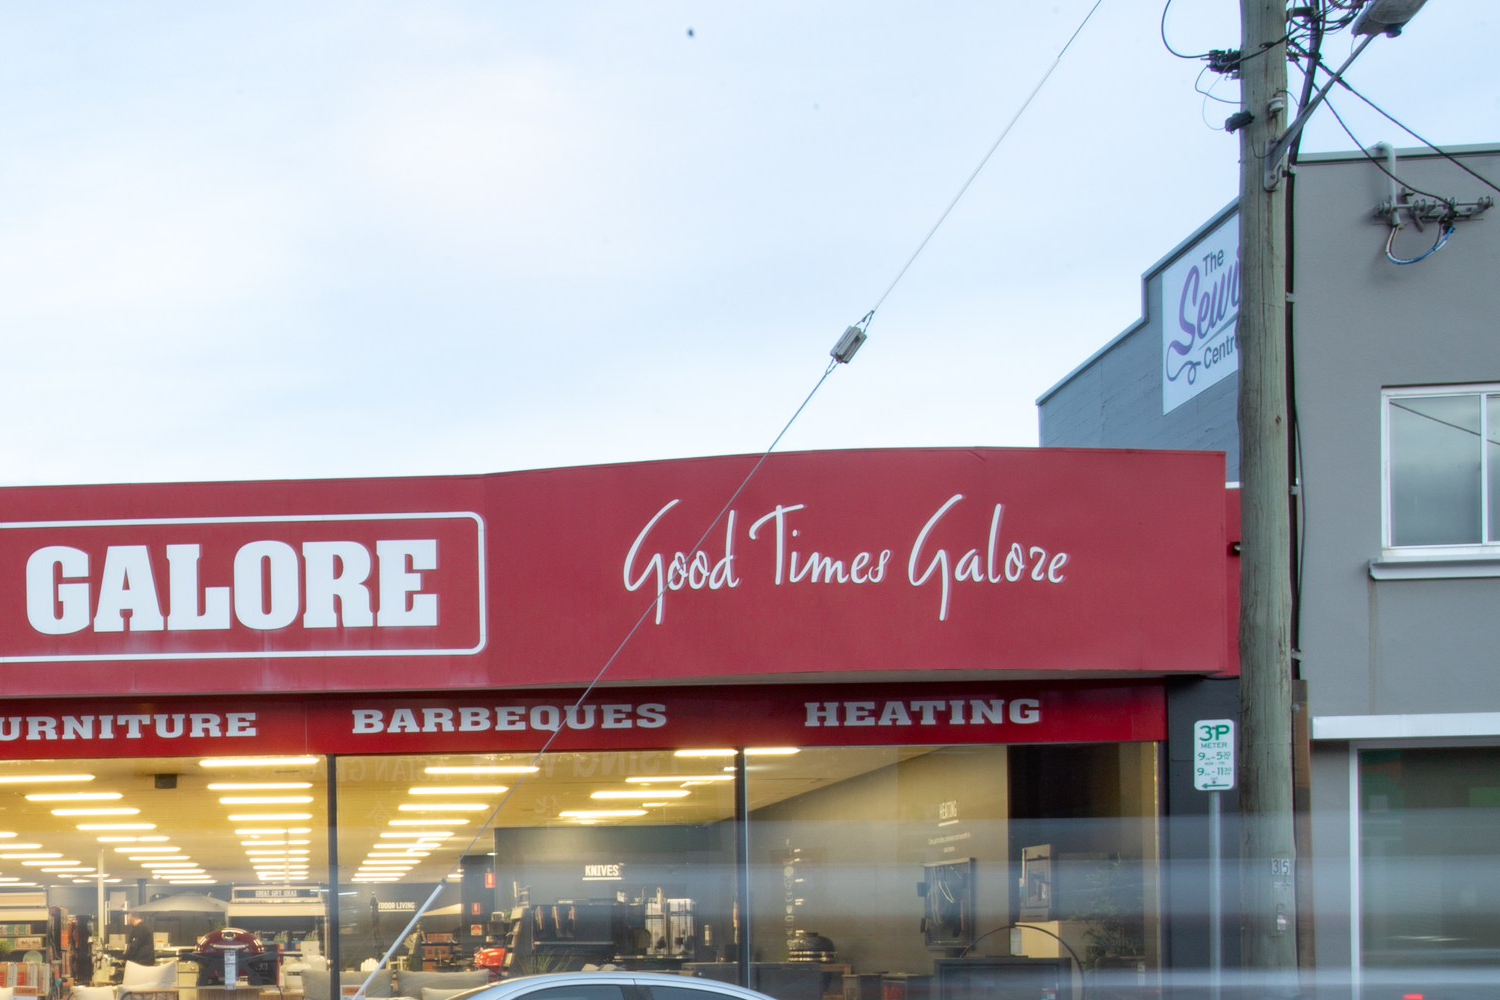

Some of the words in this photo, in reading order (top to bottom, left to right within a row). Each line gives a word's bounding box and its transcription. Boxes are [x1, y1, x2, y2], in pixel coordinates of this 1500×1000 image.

[1203, 249, 1224, 277] The
[1166, 250, 1239, 385] Sewi
[1204, 335, 1239, 369] Centr
[623, 498, 740, 625] Good
[749, 503, 891, 586] Times
[908, 493, 1068, 621] Galore
[25, 539, 438, 636] GALORE
[352, 702, 667, 734] BARBEQUES
[805, 698, 1041, 728] HEATING
[1199, 724, 1230, 741] 3P
[585, 865, 619, 876] KNIVES
